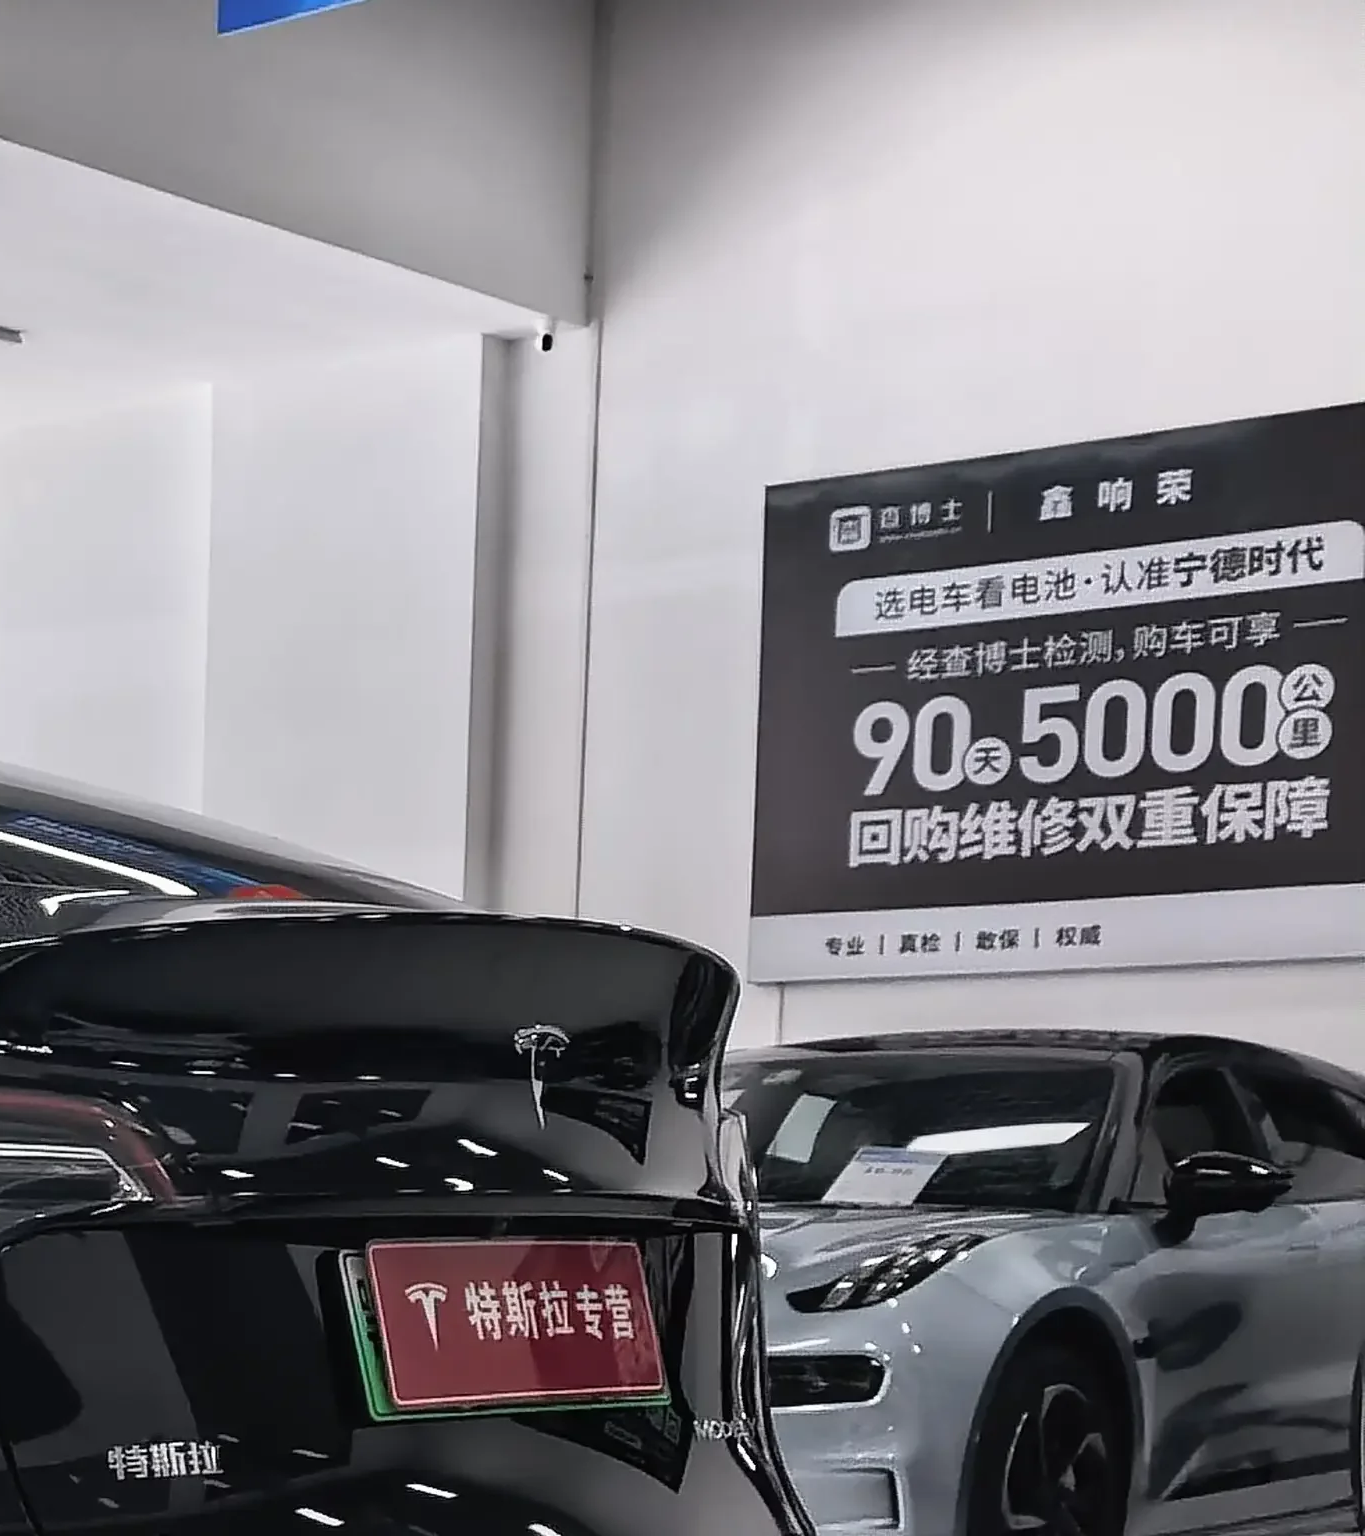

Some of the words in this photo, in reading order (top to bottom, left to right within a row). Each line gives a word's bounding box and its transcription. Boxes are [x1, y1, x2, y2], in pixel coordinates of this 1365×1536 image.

[1039, 468, 1193, 522] 鑫响荣
[848, 776, 1331, 869] 回购维修双重保障
[824, 933, 866, 956] 专业
[1055, 924, 1102, 948] 权威
[465, 1279, 635, 1343] 特斯拉专营
[107, 1440, 224, 1480] 特斯拉
